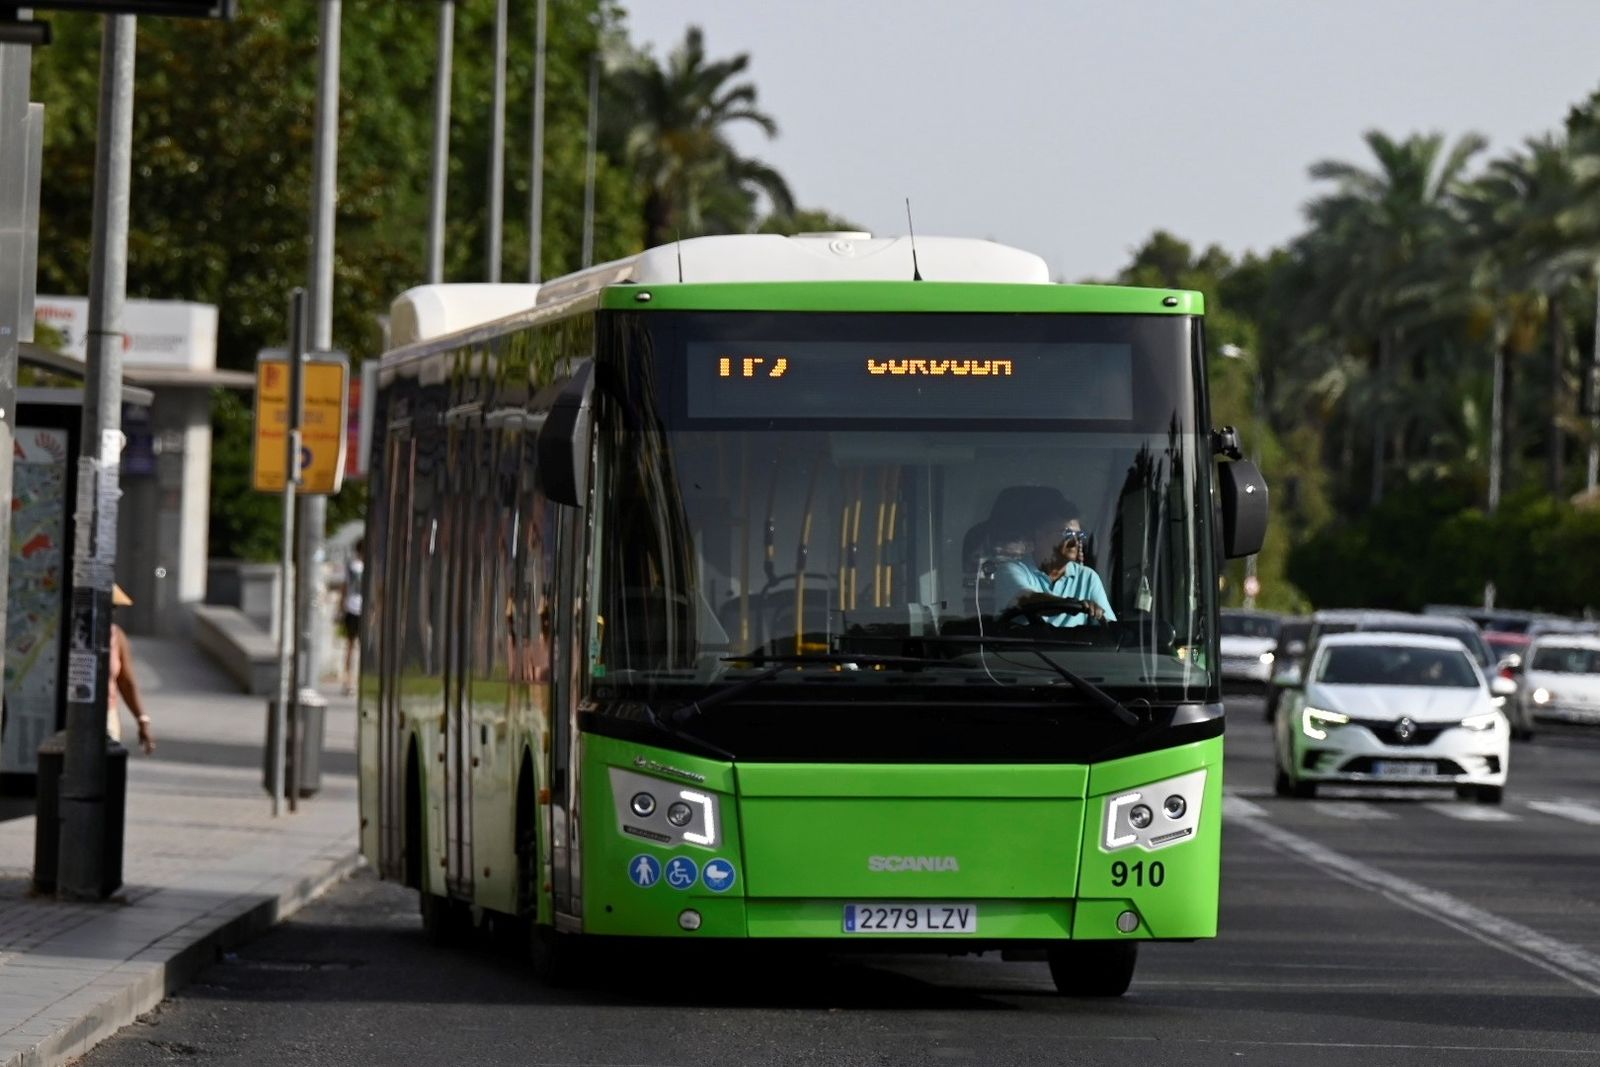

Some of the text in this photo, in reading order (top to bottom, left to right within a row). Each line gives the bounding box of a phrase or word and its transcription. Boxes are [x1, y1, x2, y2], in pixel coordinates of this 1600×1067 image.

[867, 855, 959, 872] SCANIA
[1111, 860, 1165, 887] 910
[860, 908, 970, 929] 2279 LZV
